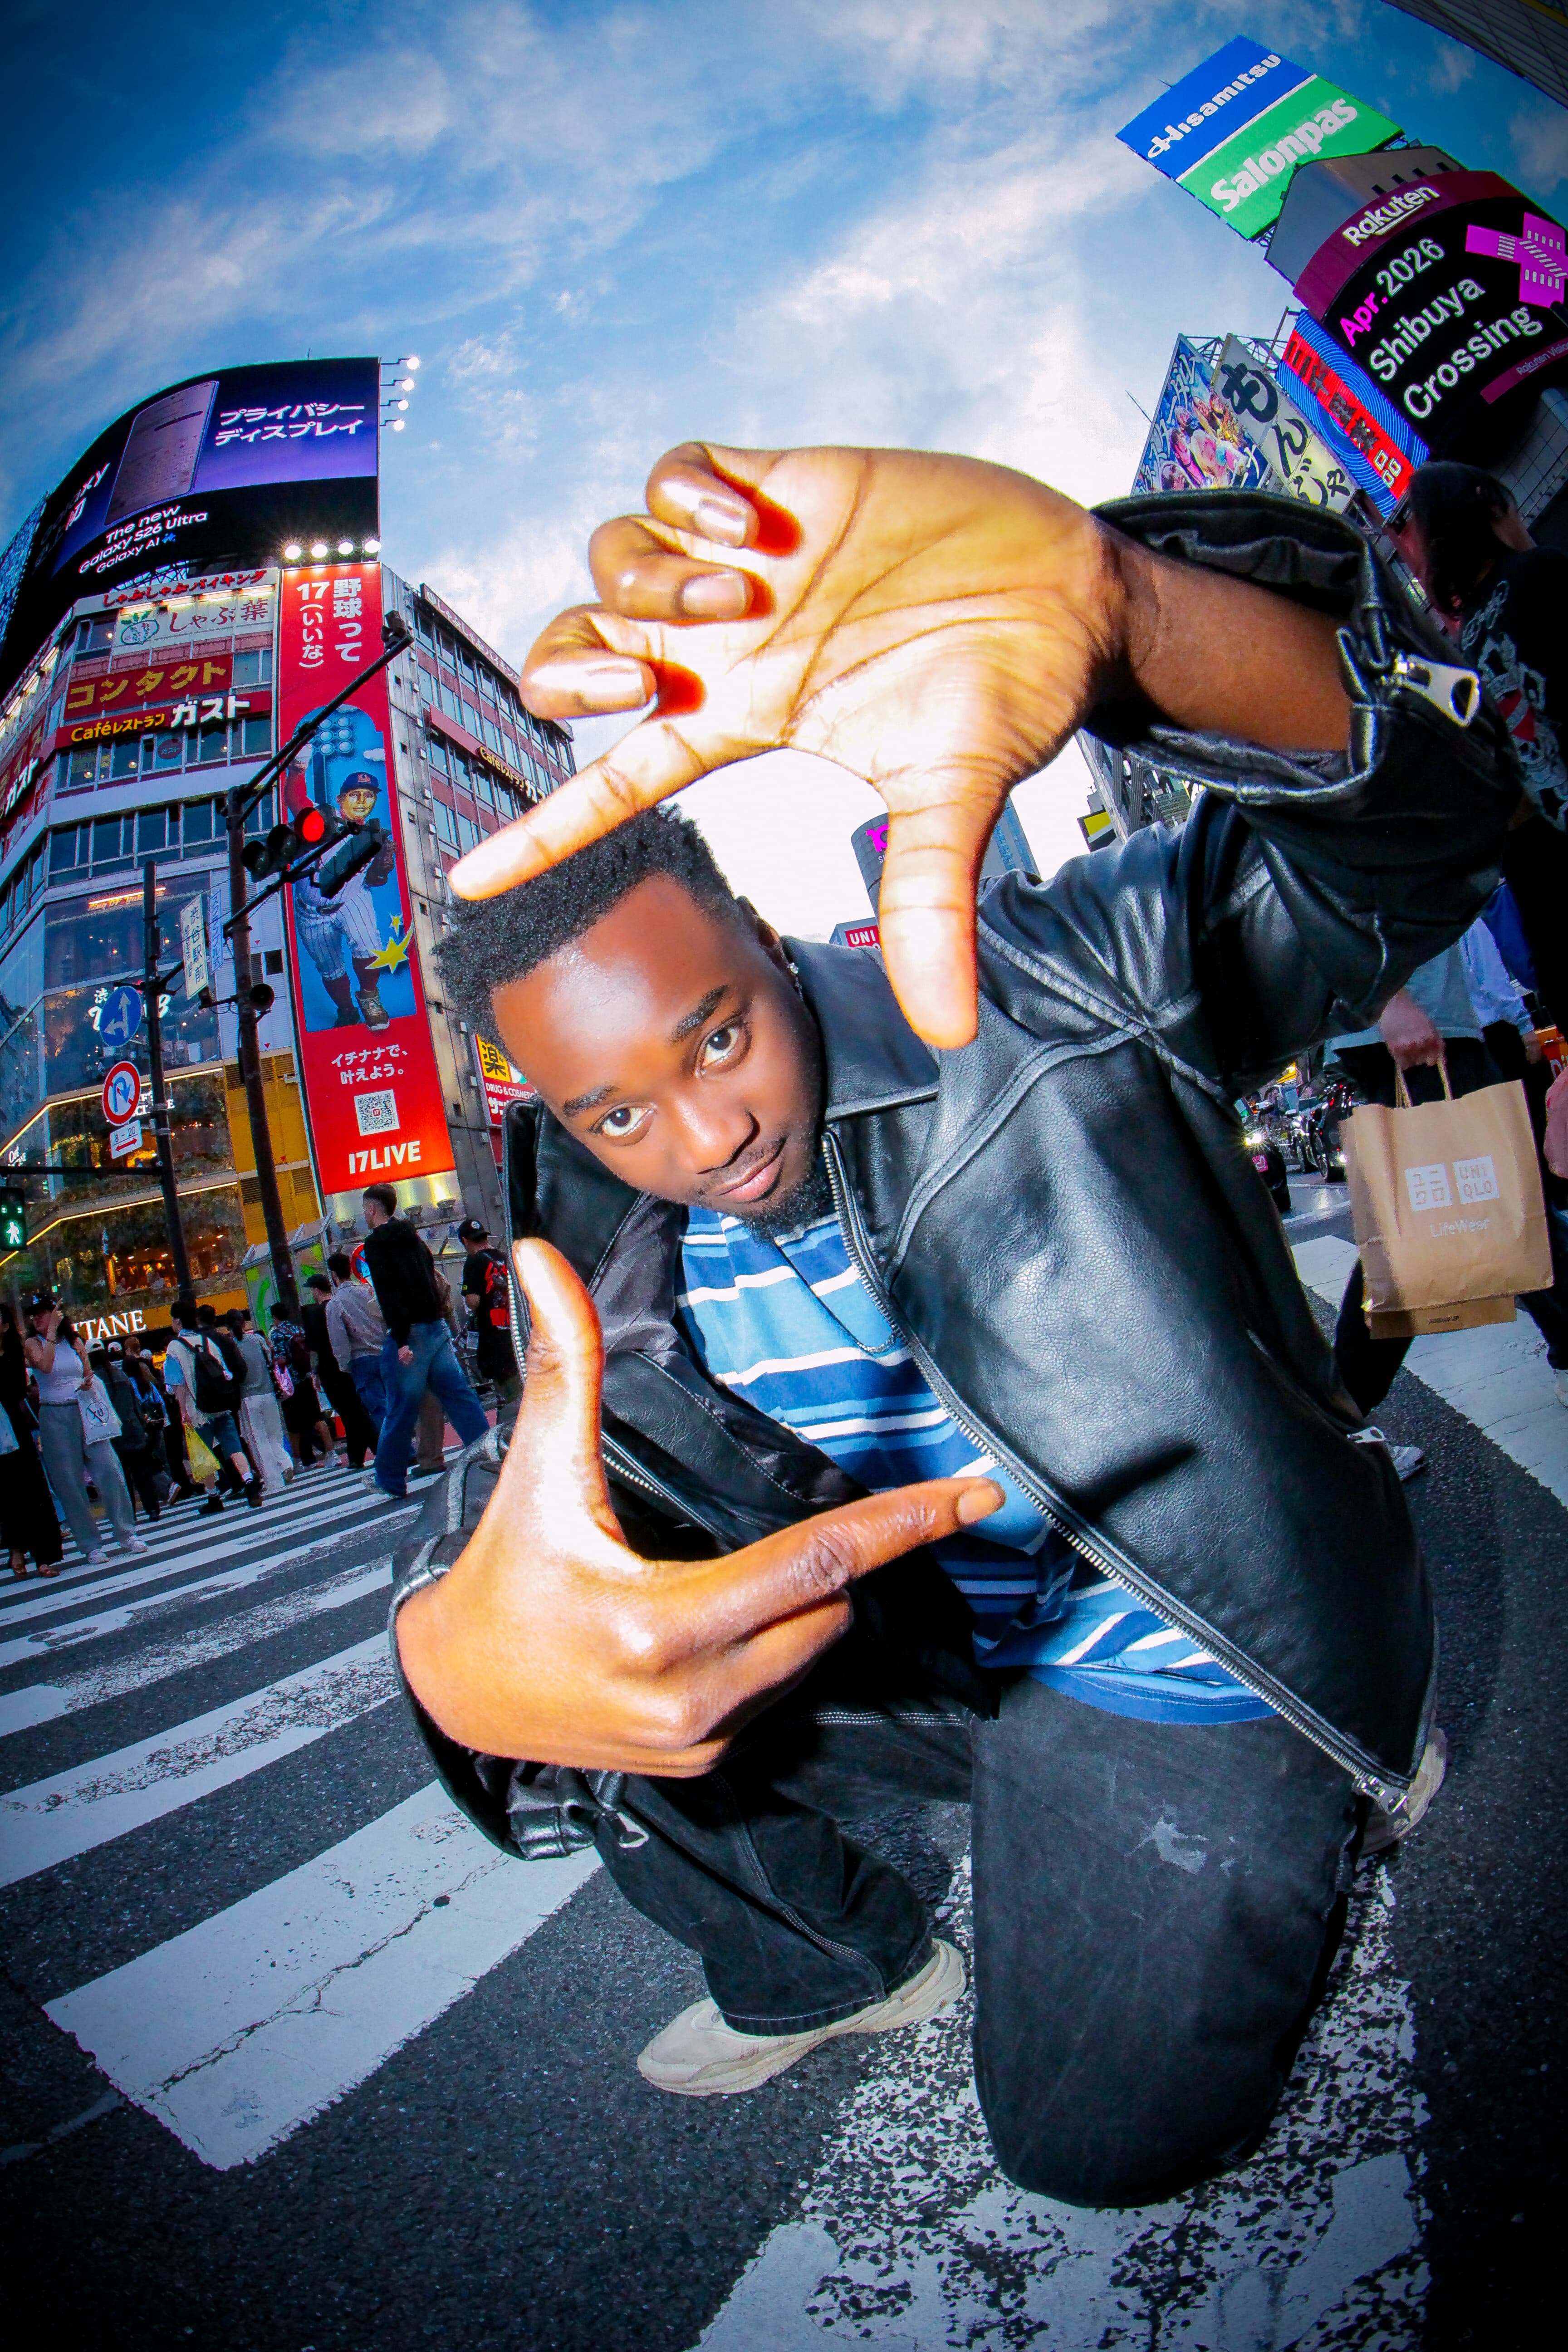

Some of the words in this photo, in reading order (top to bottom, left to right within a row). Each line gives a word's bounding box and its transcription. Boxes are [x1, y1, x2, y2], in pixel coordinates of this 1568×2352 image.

[1147, 54, 1282, 159] Hisamitsu
[1210, 98, 1358, 213] Salonpas
[1342, 186, 1440, 246] Rakuten
[1369, 277, 1485, 381] Shibuya
[1403, 306, 1543, 418] Crossing
[1516, 353, 1550, 375] Rakuten
[220, 402, 364, 426] プライバシー
[216, 419, 363, 446] ディスプレイ
[1220, 363, 1351, 505] もんじゃ
[78, 536, 133, 573] Galaxy
[134, 523, 162, 541] S26
[166, 511, 208, 530] Ultra
[106, 523, 135, 544] The
[138, 505, 181, 528] new
[96, 544, 144, 573] Galaxy
[146, 537, 160, 549] AI
[103, 570, 267, 607] しゃぶしゃぶバイキング
[169, 598, 269, 632] しゃぶ葉
[333, 578, 362, 662] 野球って
[68, 662, 226, 710] コンタクト
[171, 696, 250, 728] ガスト
[190, 906, 204, 984] 渋谷駅前
[849, 930, 876, 945] UNI
[340, 1063, 404, 1084] 叶えよう。
[485, 1083, 503, 1094] DRUG
[349, 1141, 421, 1174] 17LIVE
[1459, 1163, 1487, 1180] UNI
[1416, 1187, 1445, 1205] クロ
[1463, 1181, 1492, 1199] QLO
[1430, 1219, 1490, 1238] LifeWear
